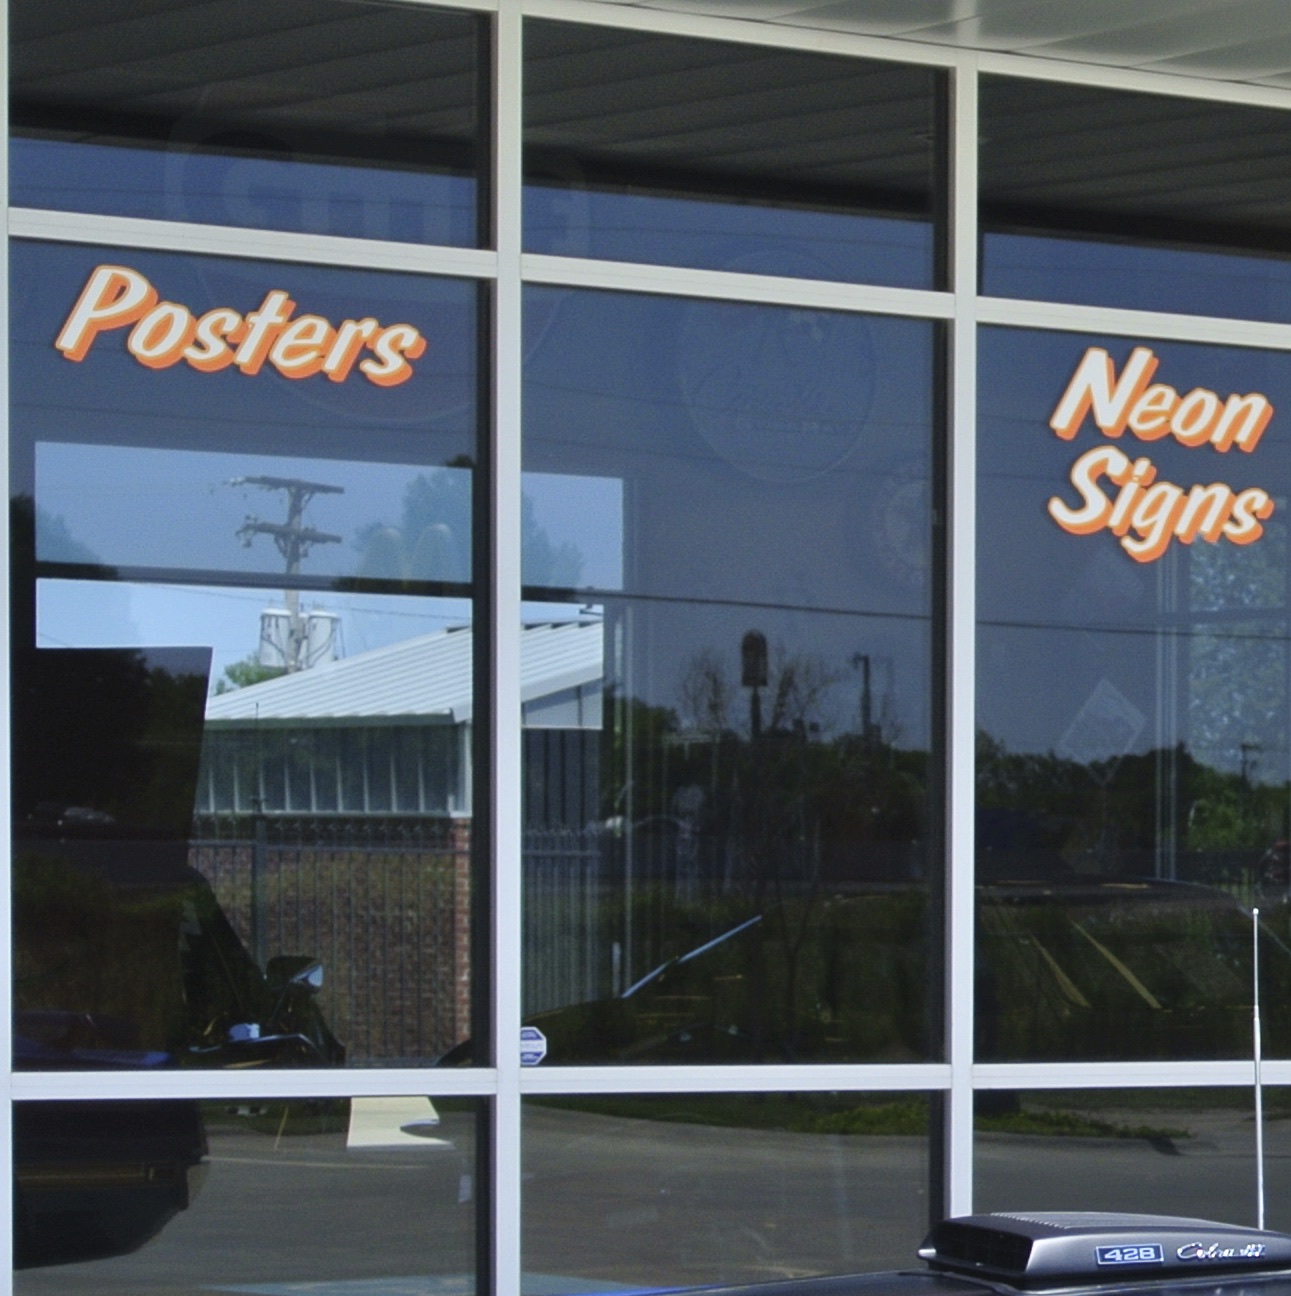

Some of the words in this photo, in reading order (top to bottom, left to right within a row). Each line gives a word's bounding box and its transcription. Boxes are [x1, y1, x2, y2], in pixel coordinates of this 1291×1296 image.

[56, 264, 428, 388] Posters
[1050, 346, 1274, 453] Neon
[1047, 445, 1275, 563] Signs
[1103, 1247, 1156, 1262] 428
